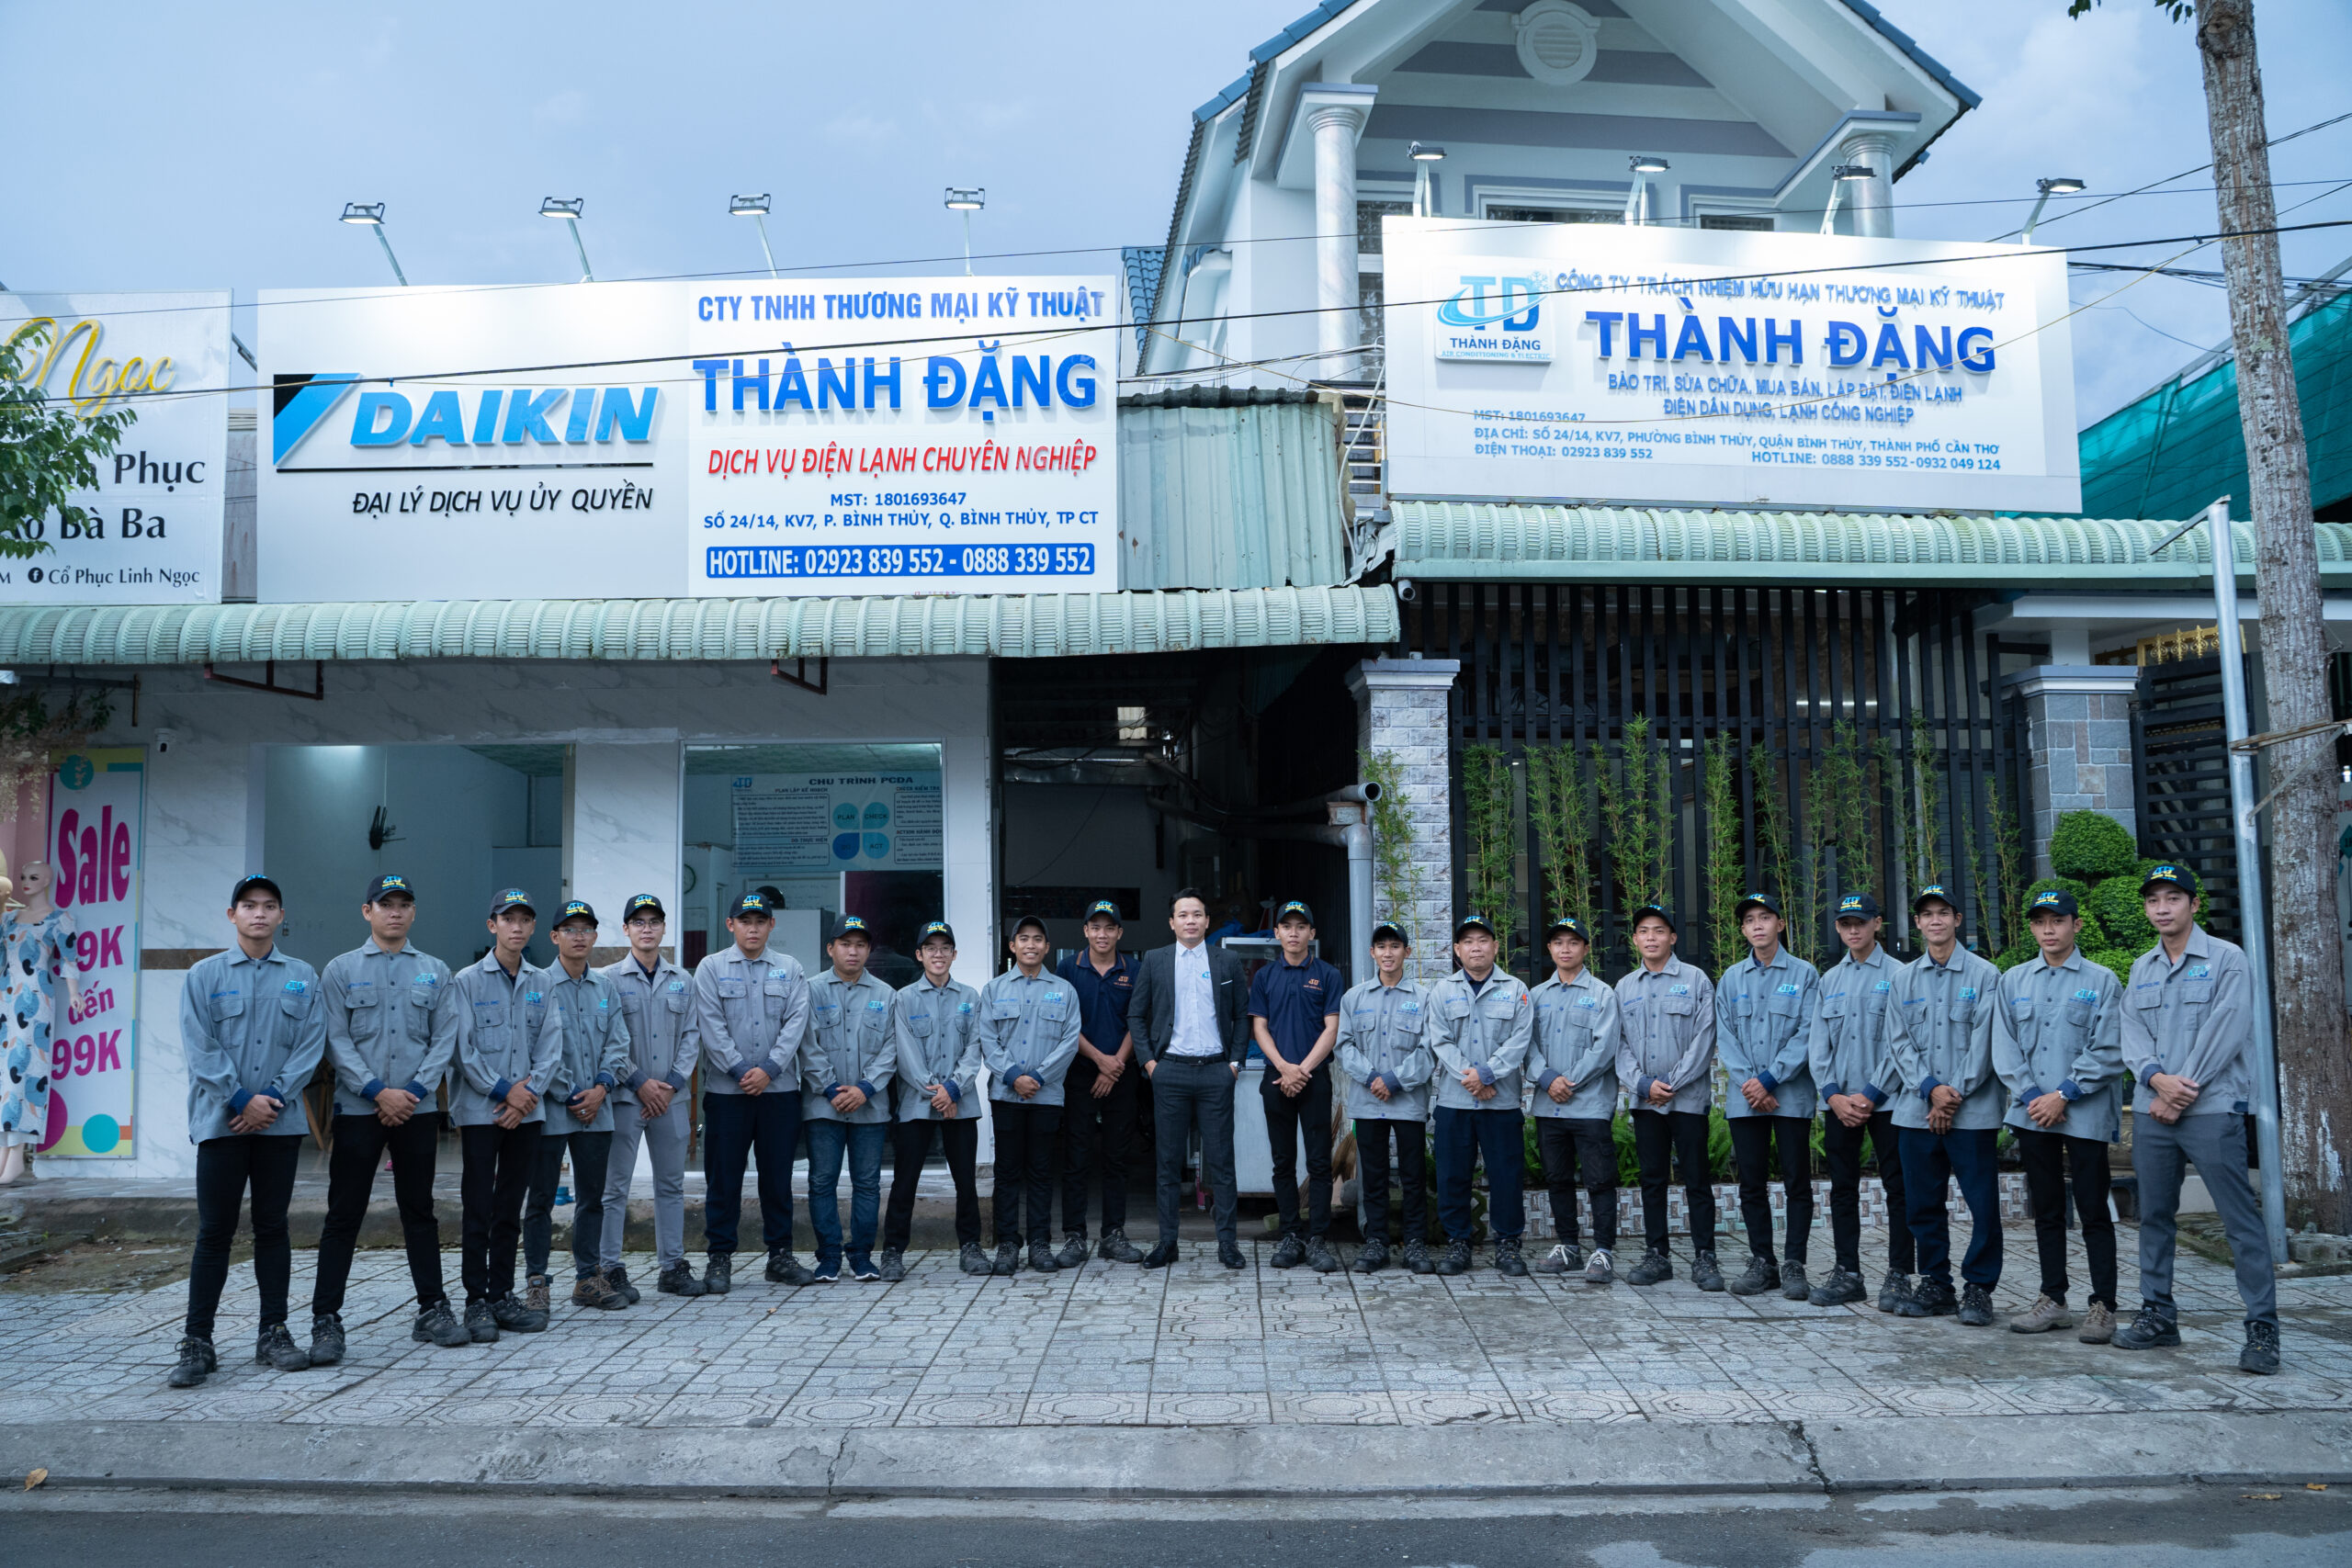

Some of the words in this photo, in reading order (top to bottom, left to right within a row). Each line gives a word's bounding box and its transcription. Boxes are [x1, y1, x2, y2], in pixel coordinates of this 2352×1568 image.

[698, 296, 742, 321] CTY
[751, 295, 815, 321] TNHH
[823, 291, 922, 320] THƯƠNG
[931, 292, 978, 323] MẠI
[988, 287, 1020, 318] KỸ
[1027, 286, 1104, 321] THUẬT
[1609, 275, 1630, 294] TY
[1637, 272, 1693, 296] TRÁCH
[1788, 282, 1820, 305] HẠN
[1897, 287, 1924, 310] MẠI
[1449, 334, 1498, 349] THÀNH
[1502, 336, 1542, 353] ĐẶNG
[1586, 297, 1804, 365] THÀNH
[1825, 306, 1996, 382] ĐẶNG
[693, 342, 901, 412] THÀNH
[923, 340, 1097, 421] ĐẶNG
[1609, 370, 1639, 389] BẢO
[1674, 372, 1703, 392] SỬA
[1756, 378, 1787, 396] MUA
[1925, 386, 1962, 405] LẠNH
[350, 387, 660, 446] DAIKIN
[1474, 410, 1504, 421] MST:
[1509, 411, 1586, 423] 1801693647
[1700, 396, 1729, 415] DÂN
[1780, 403, 1817, 423] LẠNH
[1821, 401, 1860, 421] CÔNG
[1865, 405, 1915, 426] NGHIỆP
[1475, 427, 1498, 441] ĐỊA
[1532, 424, 1551, 439] SỐ
[1554, 429, 1592, 443] 24/14,
[1596, 431, 1623, 444] KV7,
[1628, 429, 1681, 444] PHƯỜNG
[1685, 431, 1715, 445] BÌNH
[1758, 434, 1792, 450] QUẬN
[1797, 435, 1826, 448] BÌNH
[1870, 437, 1912, 452] THÀNH
[1916, 438, 1940, 452] PHỐ
[1973, 443, 2000, 455] THƠ
[1475, 442, 1507, 457] ĐIỆN
[1511, 445, 1555, 459] THOẠI:
[1561, 446, 1600, 457] 02923
[1603, 447, 1626, 458] 839
[1630, 447, 1653, 458] 552
[115, 450, 206, 492] Phục
[708, 449, 759, 479] DỊCH
[766, 448, 797, 479] VỤ
[802, 441, 854, 479] ĐIỆN
[859, 447, 917, 479] LẠNH
[922, 439, 1010, 471] CHUYÊN
[1015, 438, 1097, 477] NGHIỆP
[1752, 451, 1816, 464] HOTLINE:
[1822, 454, 1854, 465] 0888
[1859, 455, 1882, 466] 339
[1951, 457, 1974, 469] 049
[1977, 458, 2001, 470] 124
[353, 492, 391, 519] ĐẠI
[399, 485, 424, 513] LÝ
[429, 491, 482, 517] DỊCH
[491, 490, 523, 516] VỤ
[529, 481, 562, 511] ỦY
[571, 479, 653, 513] QUYỀN
[831, 493, 867, 506] MST:
[875, 492, 967, 506] 1801693647
[121, 508, 167, 538] Ba
[704, 510, 725, 529] SỐ
[729, 513, 779, 531] 24/14,
[785, 514, 817, 530] KV7,
[824, 514, 837, 526] P.
[843, 510, 883, 526] BÌNH
[888, 509, 933, 529] THỦY,
[939, 513, 955, 528] Q.
[960, 509, 1001, 525] BÌNH
[1005, 508, 1050, 528] THỦY,
[1057, 512, 1075, 525] TP
[1080, 512, 1098, 525] CT
[710, 550, 798, 575] HOTLINE:
[805, 548, 863, 575] 02923
[868, 548, 903, 574] 839
[909, 548, 944, 573] 552
[962, 547, 1009, 573] 0888
[1014, 547, 1049, 572] 339
[1056, 547, 1091, 572] 552
[49, 565, 71, 584] Cổ
[75, 569, 113, 587] Phục
[119, 568, 153, 583] Linh
[159, 568, 200, 588] Ngọc
[838, 775, 876, 785] TRÌNH
[880, 776, 913, 784] PCDA
[55, 805, 130, 908] Sale
